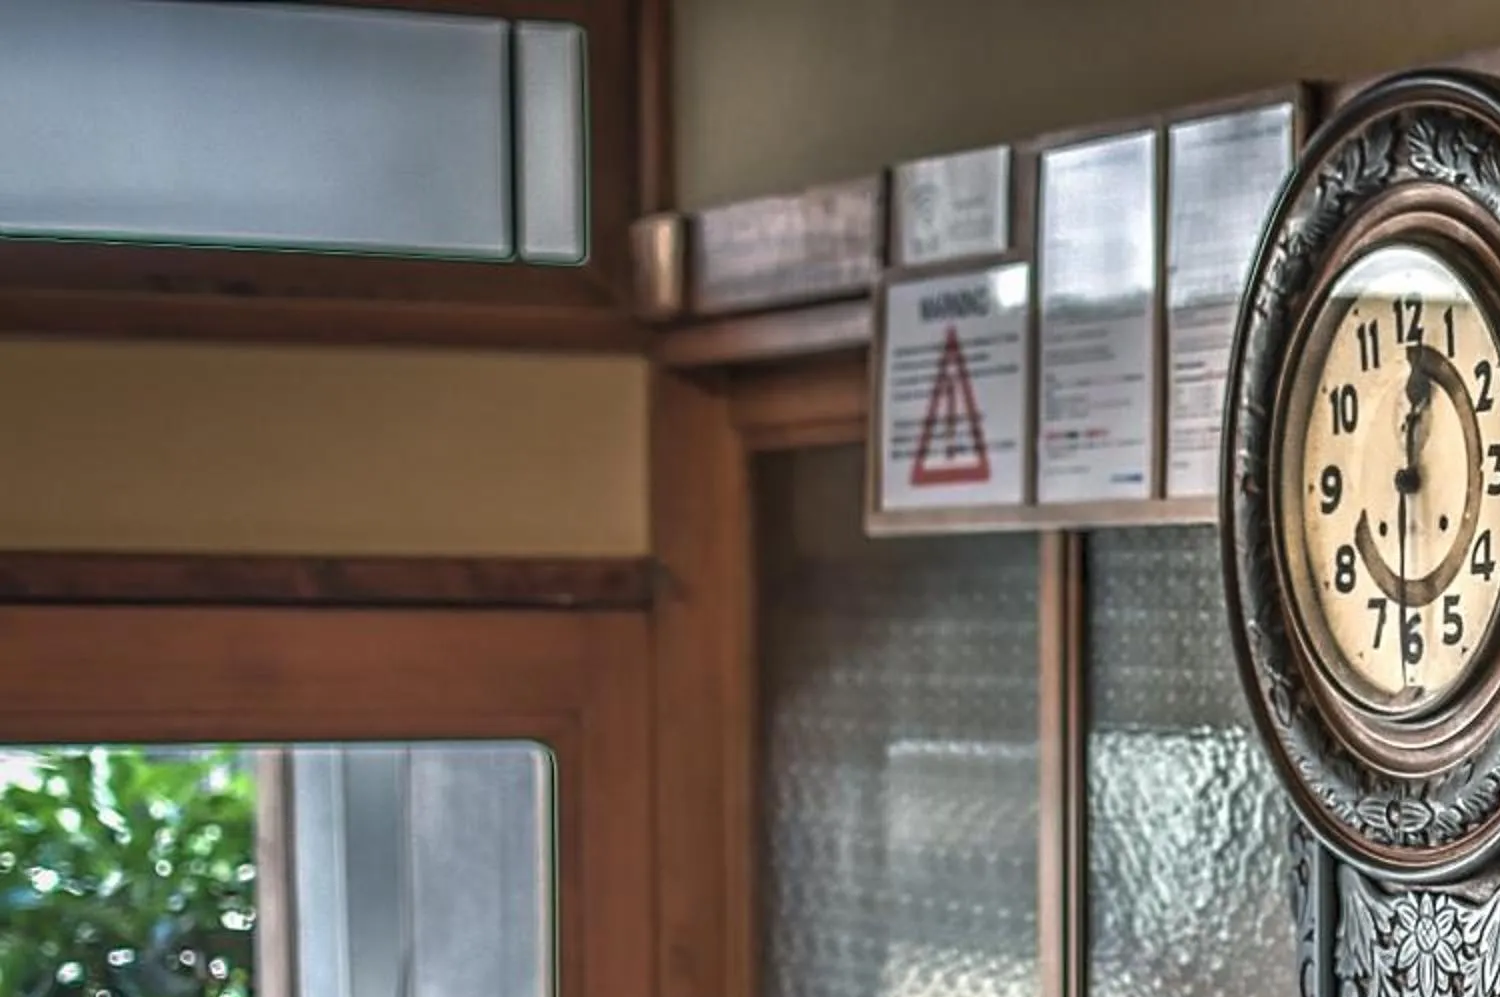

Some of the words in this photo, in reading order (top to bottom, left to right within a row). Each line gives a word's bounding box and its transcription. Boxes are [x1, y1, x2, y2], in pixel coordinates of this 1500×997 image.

[1393, 292, 1424, 344] 12
[1443, 306, 1456, 358] 1
[1356, 318, 1382, 372] 11
[1329, 383, 1359, 436] 10
[1474, 359, 1494, 412] 2
[1320, 464, 1343, 515] 9
[1334, 543, 1357, 594] 8
[1470, 529, 1496, 581] 4
[1367, 598, 1388, 649] 7
[1405, 613, 1425, 665] 6
[1442, 594, 1464, 646] 5
